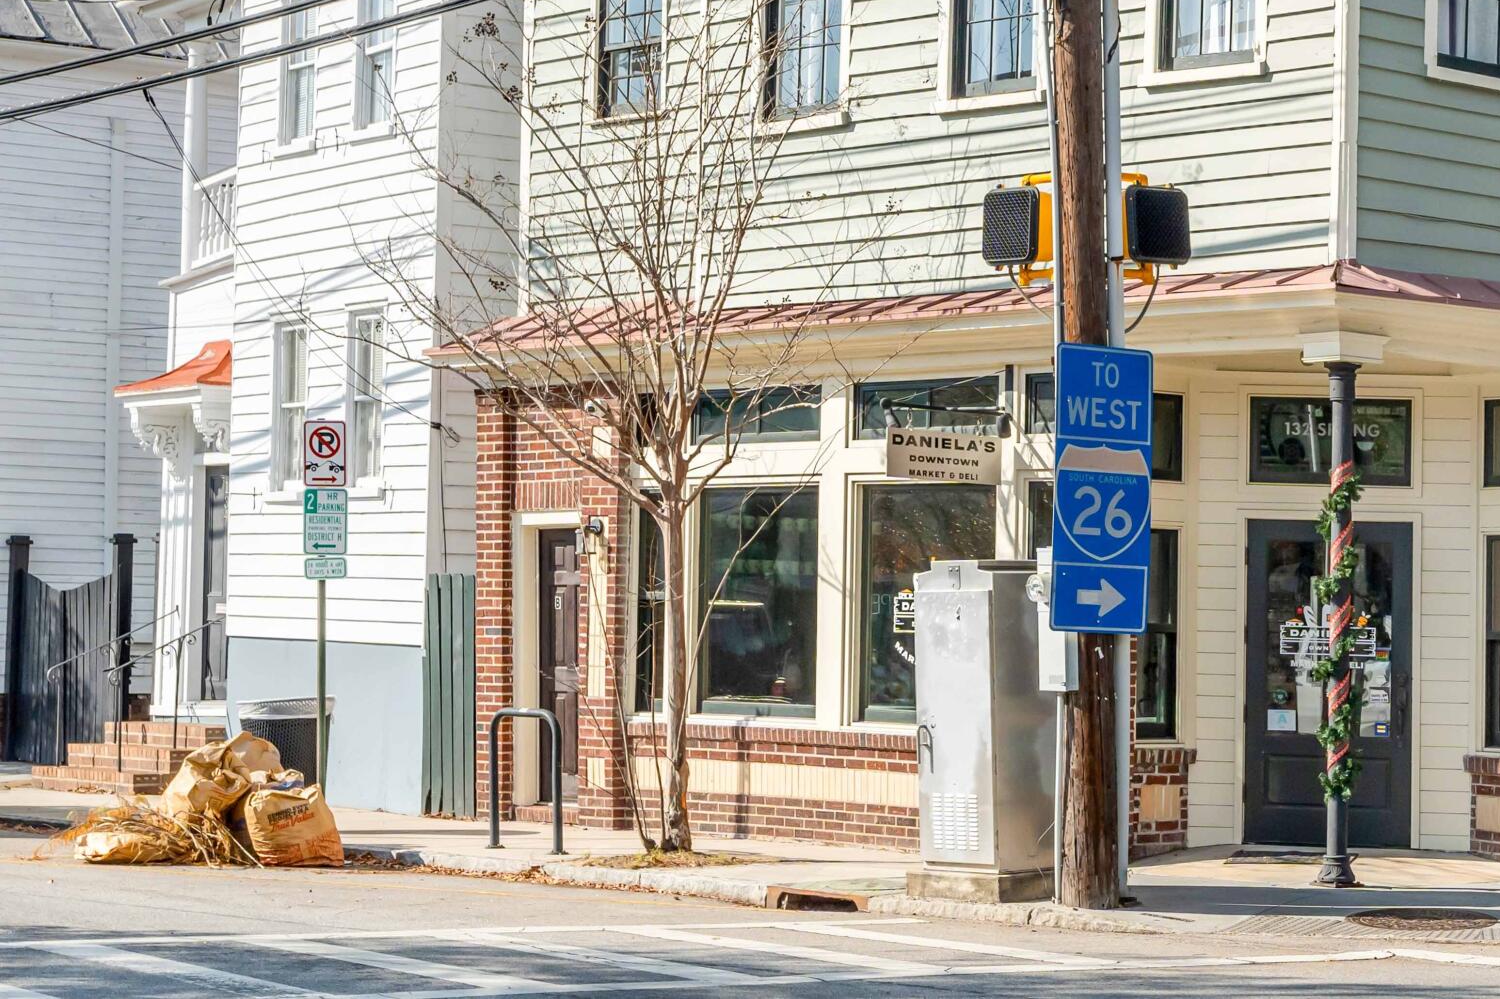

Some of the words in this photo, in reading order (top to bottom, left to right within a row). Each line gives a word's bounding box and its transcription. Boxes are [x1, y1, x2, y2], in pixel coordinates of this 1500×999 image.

[1091, 361, 1120, 389] TO
[1067, 395, 1142, 431] WEST
[1284, 421, 1311, 436] 132
[892, 433, 996, 453] DANIELA'S
[909, 454, 979, 467] DOWNTOWN
[908, 469, 946, 479] MARKET
[959, 473, 978, 481] DELI
[1069, 473, 1095, 482] SOUTH
[1098, 474, 1138, 485] CAROLINA
[307, 493, 315, 510] 2
[327, 492, 338, 500] HR
[318, 503, 345, 512] PARKING
[1072, 485, 1133, 539] 26
[309, 516, 342, 524] RESIDENTIAL
[308, 532, 334, 541] DISTRICT
[337, 533, 342, 541] H
[1348, 661, 1364, 669] ELI
